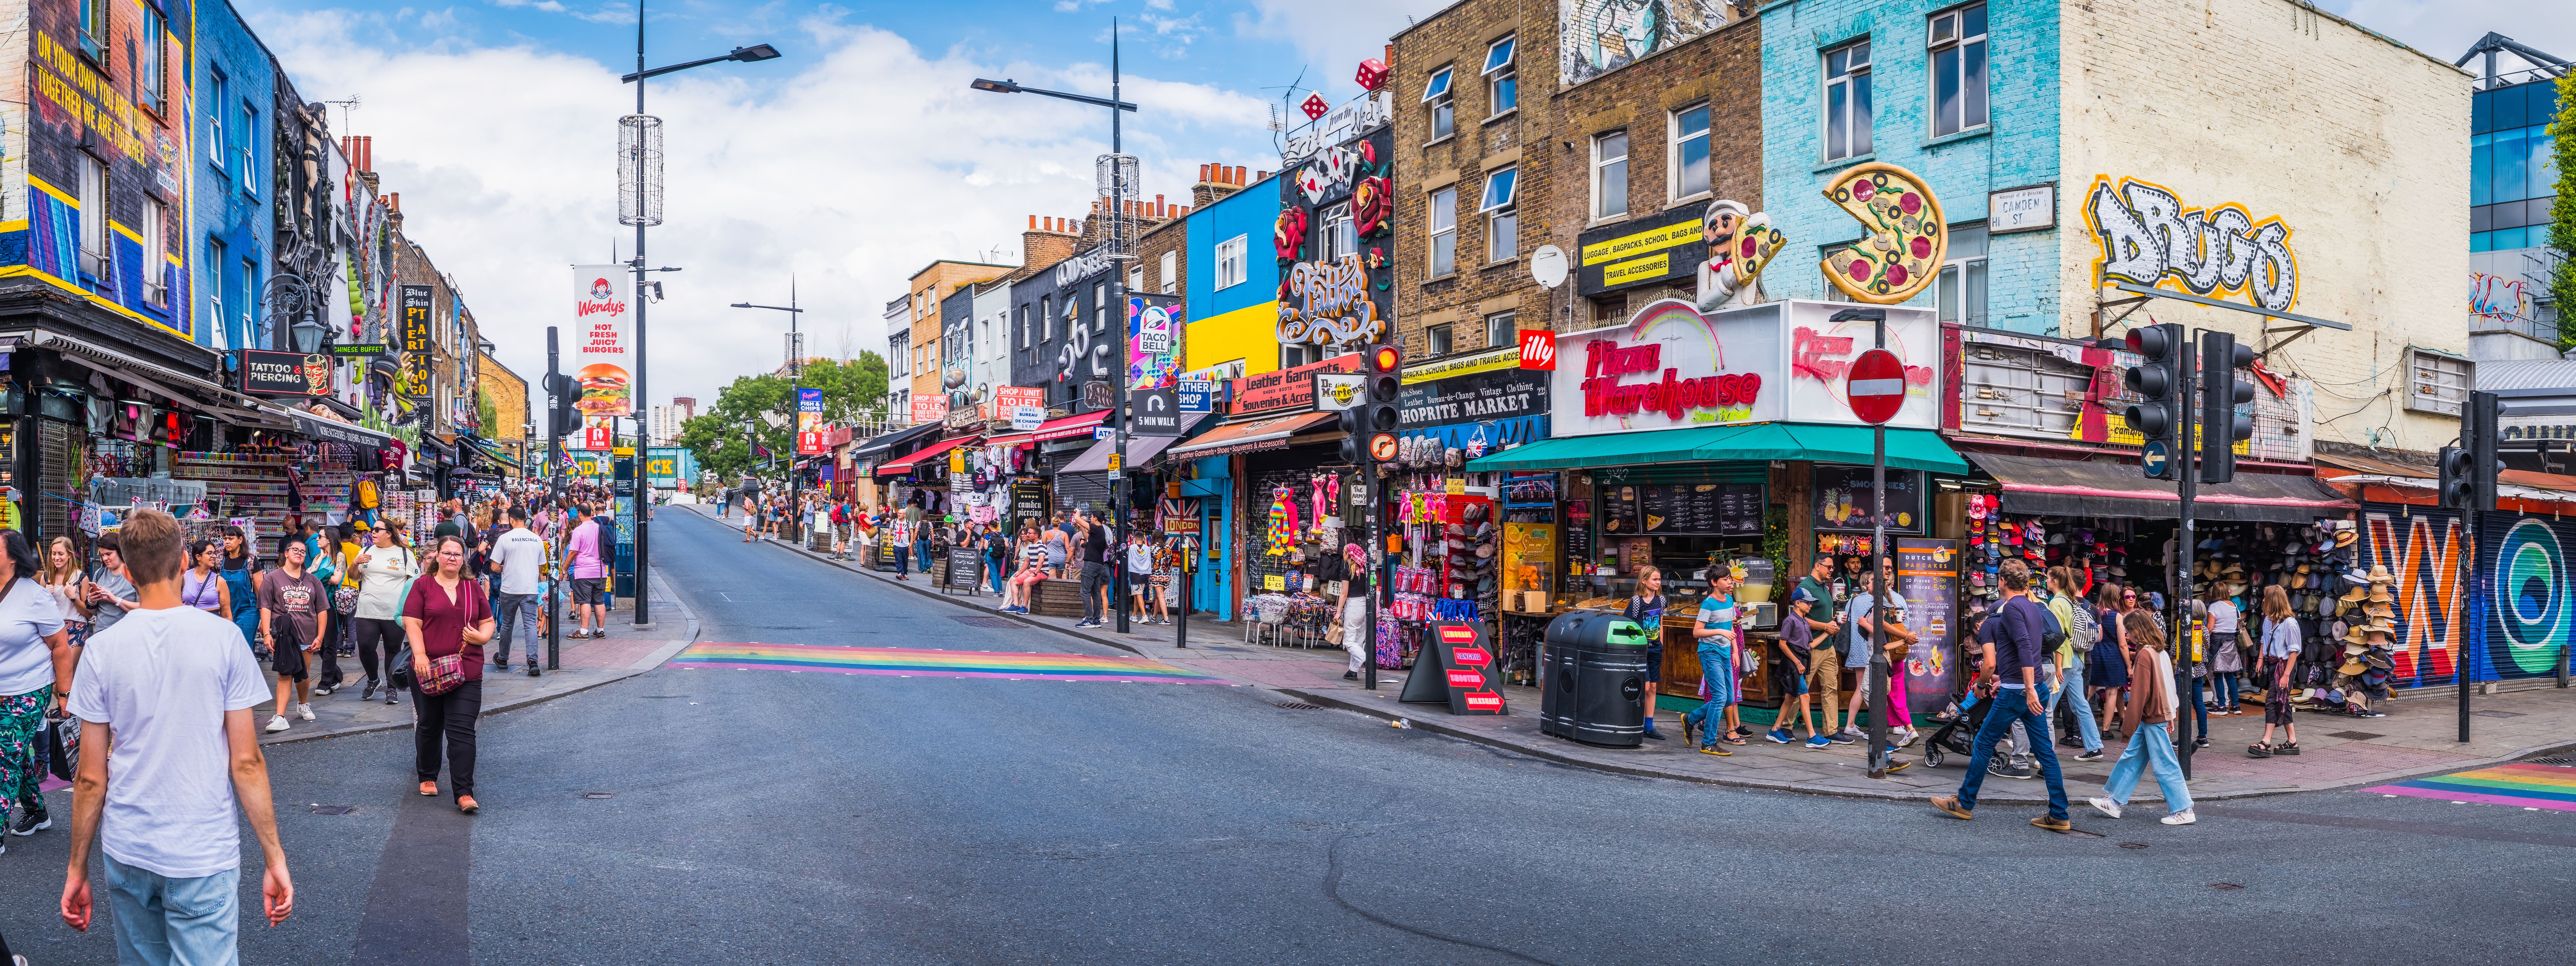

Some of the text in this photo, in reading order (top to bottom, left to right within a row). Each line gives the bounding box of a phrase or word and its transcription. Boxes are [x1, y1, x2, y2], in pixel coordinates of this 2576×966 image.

[38, 30, 153, 143] ON YOUR OWN YOU ARE TOUGH.
[38, 64, 147, 168] TOGETHER WE ARE TOUGHER.
[1328, 112, 1343, 131] from
[2003, 198, 2039, 213] CAMDEN
[1584, 225, 1703, 260] LUGGAGE BAGPACKS, SCHOOL BAGS AND
[2088, 178, 2297, 314] DRUGS
[1606, 260, 1667, 279] TRAVEL ACCESSORIES
[405, 288, 427, 297] Blue
[405, 298, 428, 307] Skin
[578, 300, 625, 317] Wendy's
[1141, 332, 1167, 342] TACO
[1792, 326, 1854, 355] Pizza
[417, 309, 427, 395] TATTOO
[1142, 341, 1166, 350] BELL
[1523, 335, 1554, 367] illy
[1425, 354, 1501, 375] SCHOOL BAGS AND TRAVEL
[1585, 339, 1661, 378] Pizza
[250, 363, 291, 373] TATTOO
[251, 372, 301, 383] PIERCING
[1246, 374, 1283, 391] Leather
[1321, 379, 1332, 388] Dr.
[802, 391, 819, 400] Poppies
[1000, 387, 1018, 395] SHOP
[1404, 387, 1502, 407] Leather Bureau-de-Change Vintage
[1580, 368, 1761, 420] Warehouse
[1002, 397, 1038, 407] TO LET
[1243, 396, 1281, 411] Souvenirs
[1464, 393, 1529, 417] MARKET
[1139, 416, 1175, 426] 5 MIN WALK
[1195, 448, 1214, 457] Garments
[1232, 443, 1253, 452] Souvenirs
[1258, 438, 1286, 448] Accessories
[1018, 500, 1041, 508] camden
[1017, 508, 1042, 518] piercing
[1165, 519, 1199, 532] LONDON
[1456, 652, 1482, 660] SANGRIA
[1450, 674, 1481, 682] SMOOTHIE
[1467, 697, 1500, 705] MILKSHAKE
